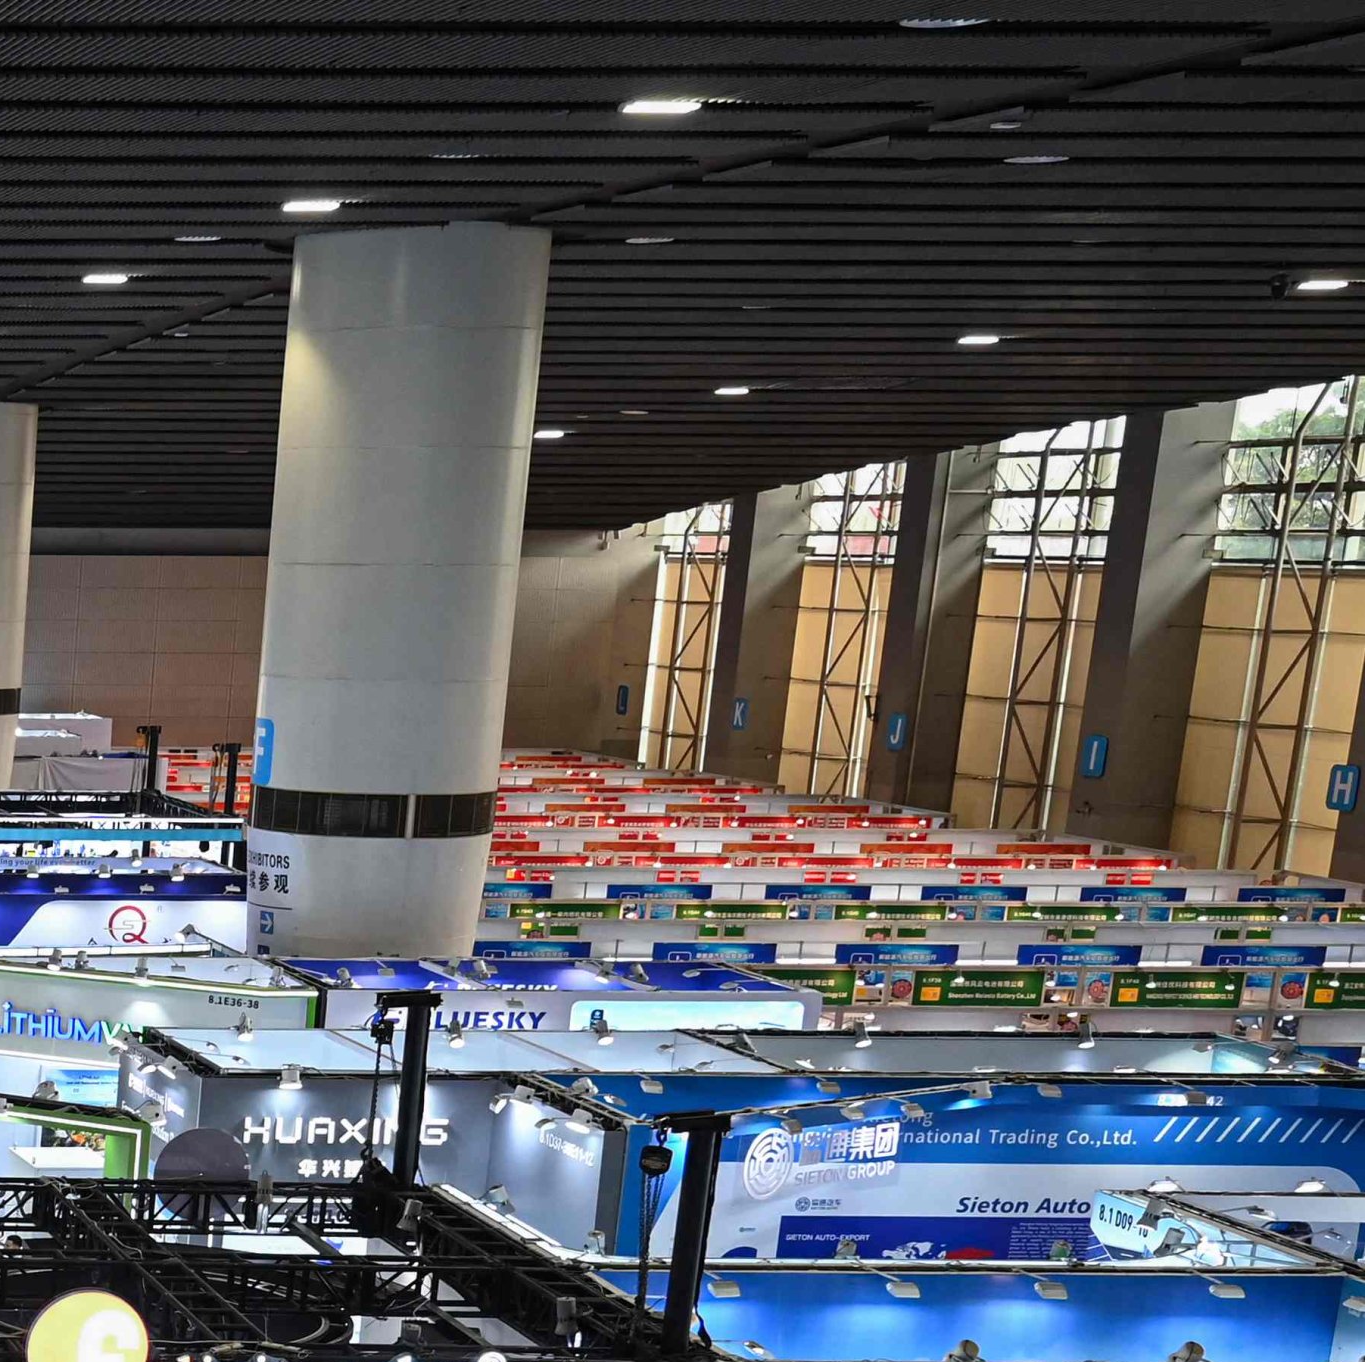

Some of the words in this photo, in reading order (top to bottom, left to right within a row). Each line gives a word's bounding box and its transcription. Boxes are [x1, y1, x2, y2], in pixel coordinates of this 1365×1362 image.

[890, 719, 901, 744] J
[1332, 771, 1352, 804] H
[208, 994, 260, 1010] 8.1E36-38
[436, 1011, 546, 1031] LUESKY
[989, 1128, 1058, 1149] Trading
[1066, 1127, 1138, 1148] Co.,Ltd.
[847, 1160, 896, 1180] GROUP
[956, 1195, 1030, 1215] Sieton
[1035, 1196, 1091, 1215] Auto
